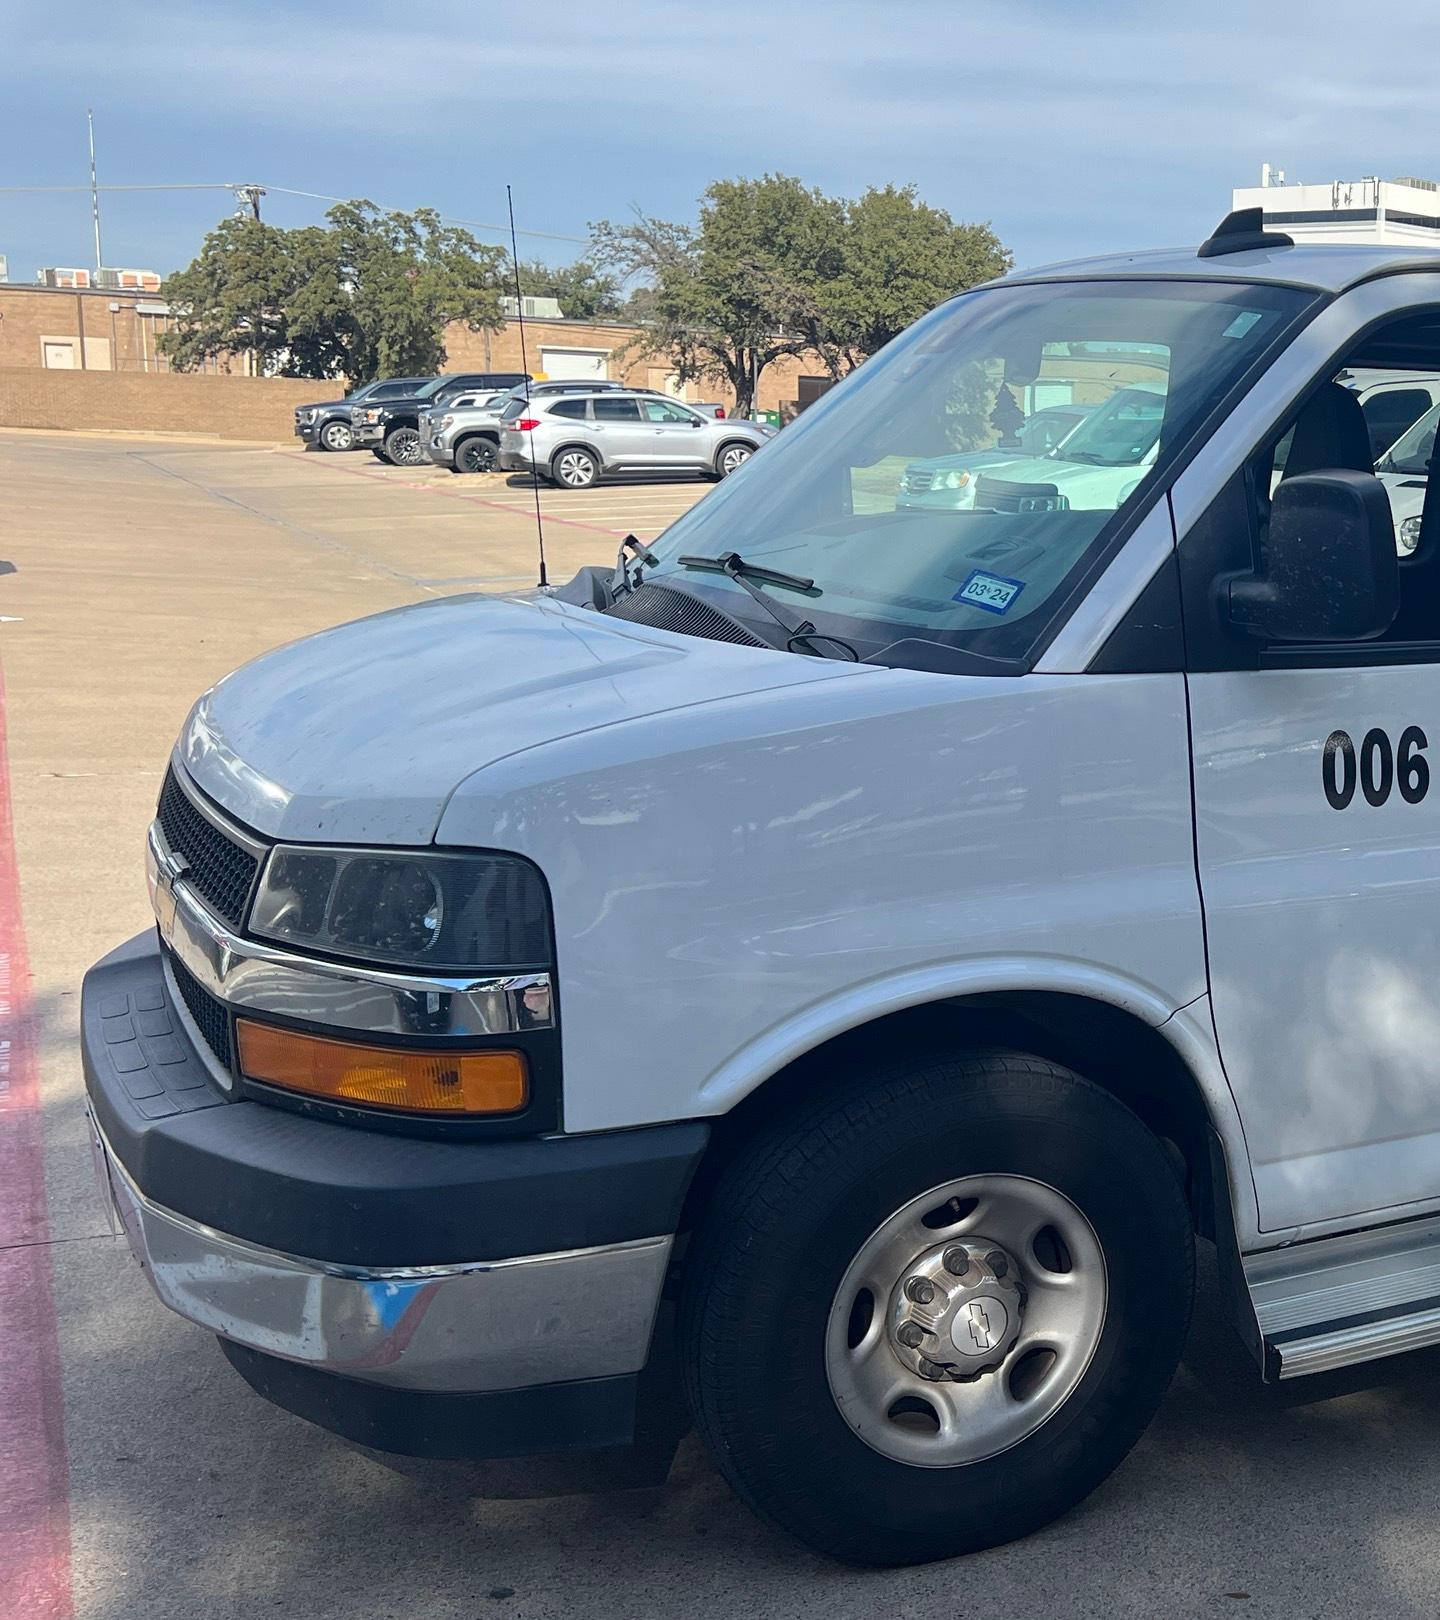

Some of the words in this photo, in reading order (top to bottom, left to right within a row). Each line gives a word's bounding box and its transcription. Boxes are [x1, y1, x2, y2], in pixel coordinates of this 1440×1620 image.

[967, 582, 987, 597] 03
[989, 588, 1010, 604] 24
[1322, 725, 1430, 811] 006
